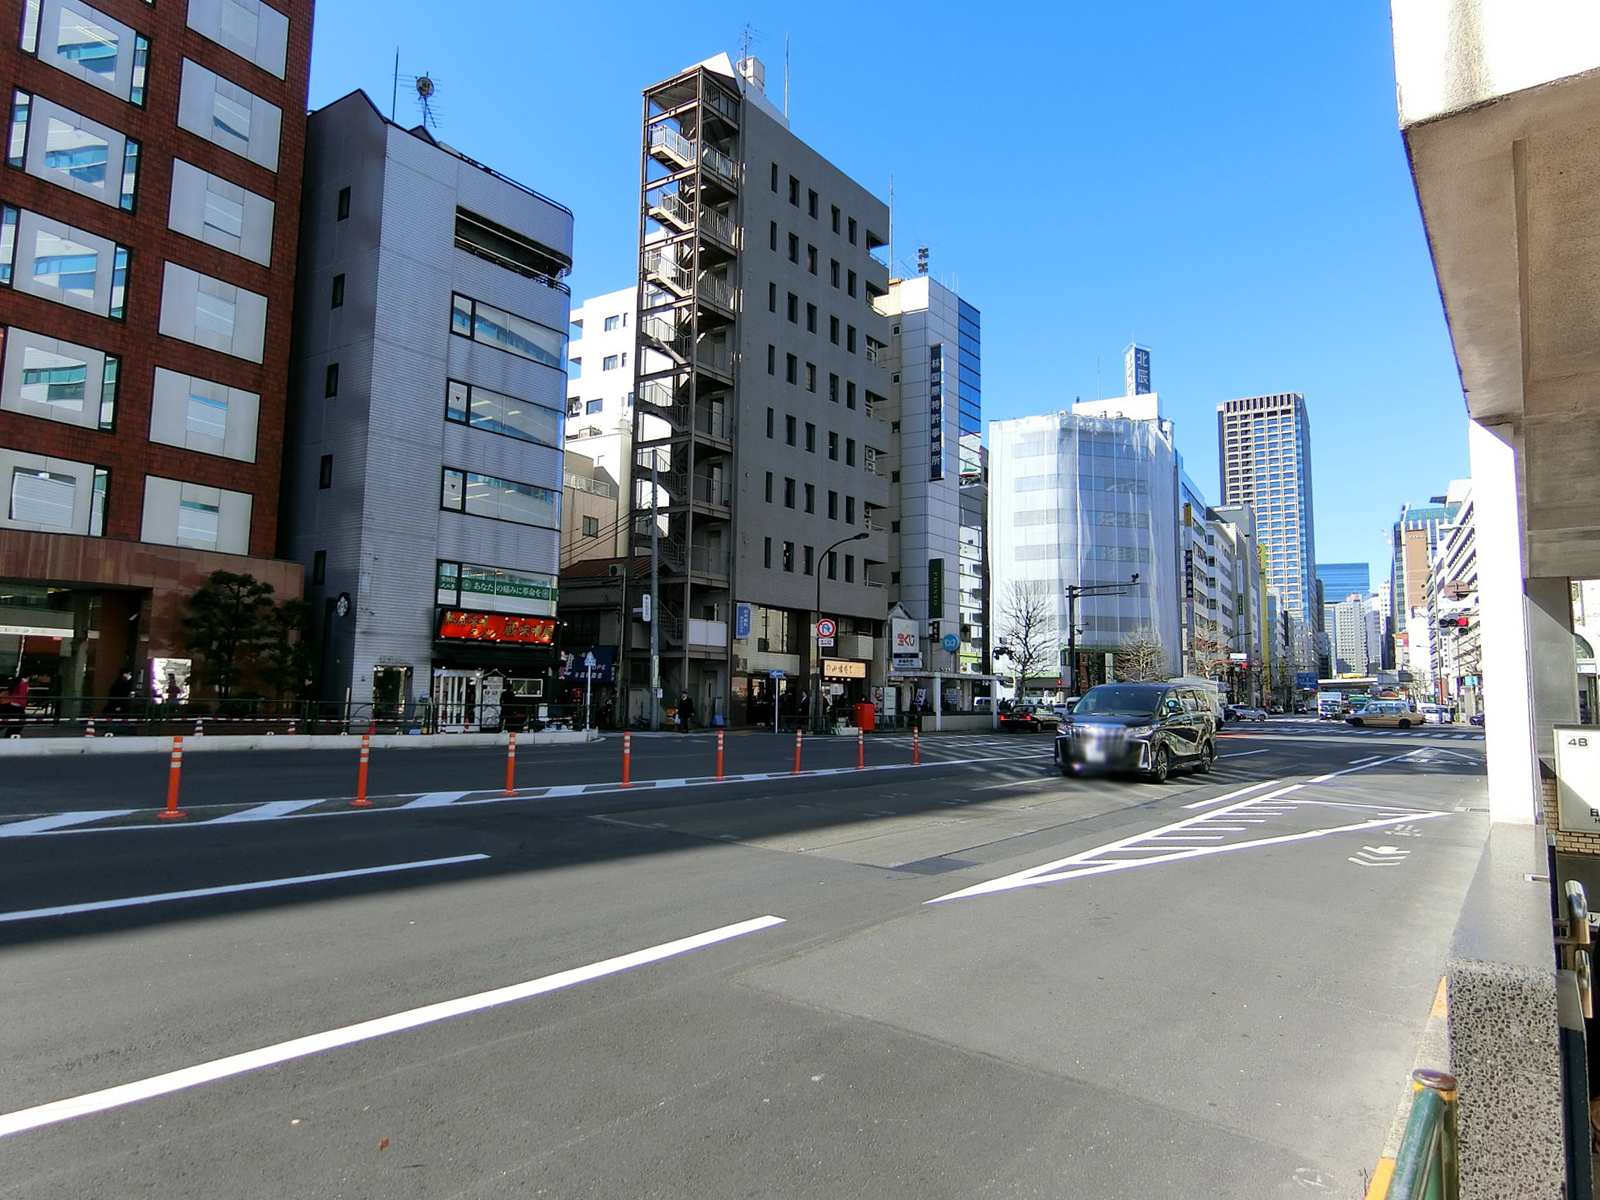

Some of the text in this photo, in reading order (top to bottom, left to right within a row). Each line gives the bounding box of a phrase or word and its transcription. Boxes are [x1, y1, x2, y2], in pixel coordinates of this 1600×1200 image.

[931, 358, 941, 466] 林国際特許事務所
[473, 581, 542, 598] あなたの痛みに革命を
[897, 632, 915, 647] 宝くじ
[1567, 737, 1588, 747] 4B
